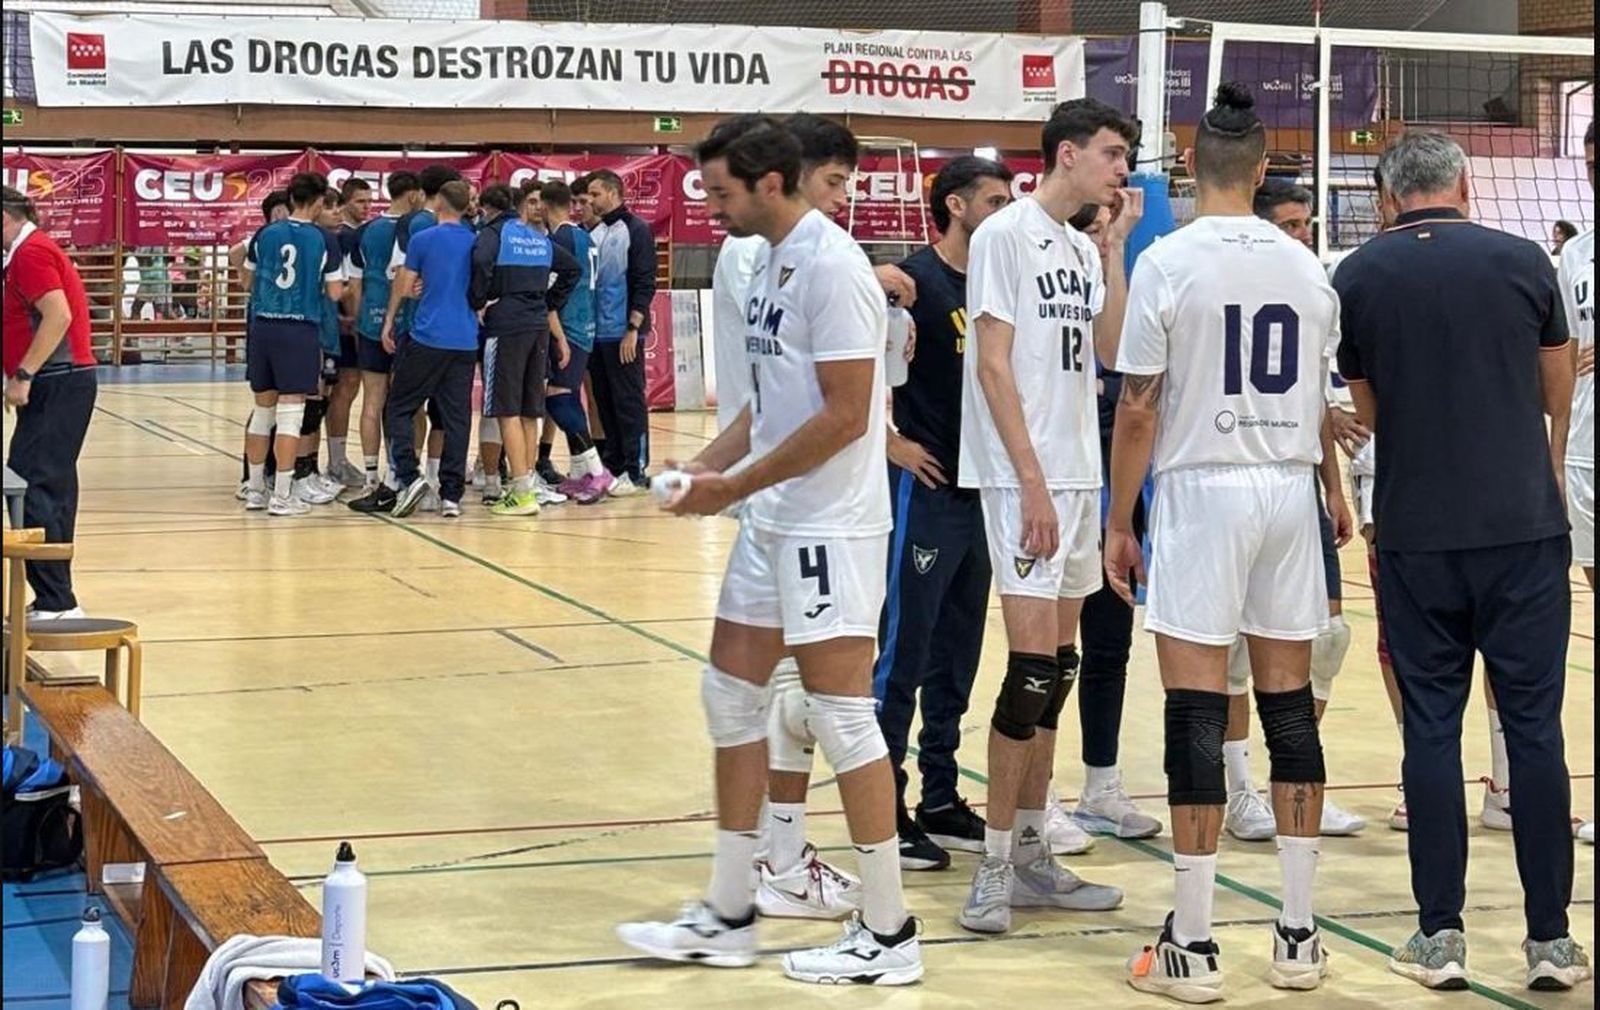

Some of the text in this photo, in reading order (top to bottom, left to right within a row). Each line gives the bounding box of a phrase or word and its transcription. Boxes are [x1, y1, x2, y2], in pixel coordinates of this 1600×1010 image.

[162, 39, 770, 85] LAS DROGAS DESTROZAN TU VIDA
[824, 42, 973, 62] PLAN REGIONAL CONTRA LAS
[827, 59, 971, 101] DROGAS
[275, 243, 298, 290] 3
[1062, 325, 1083, 373] 12
[1223, 303, 1300, 396] 10
[797, 544, 831, 597] 4
